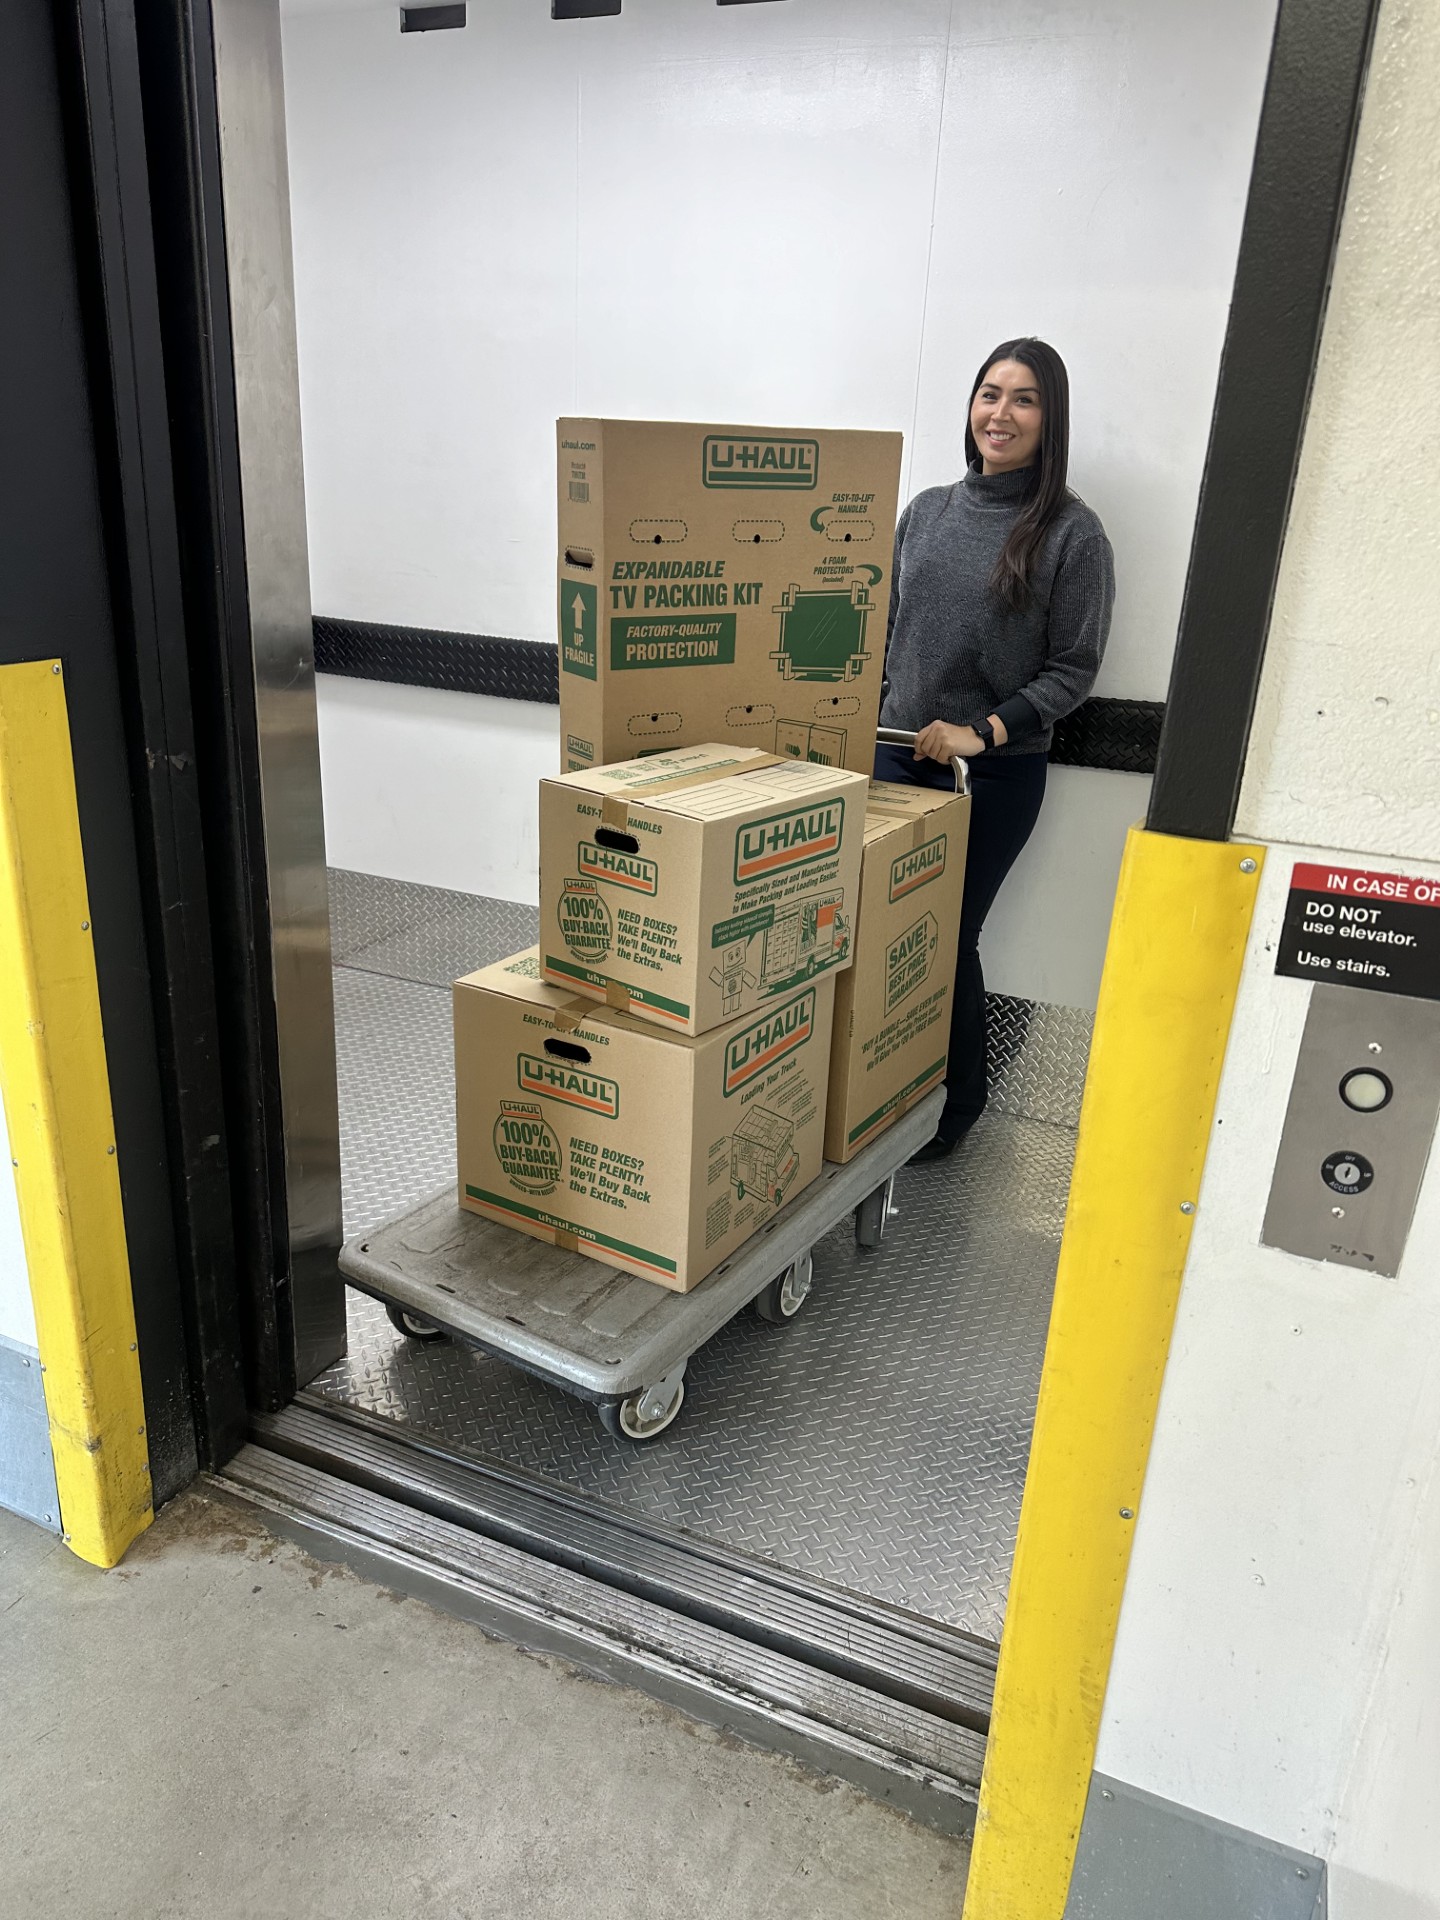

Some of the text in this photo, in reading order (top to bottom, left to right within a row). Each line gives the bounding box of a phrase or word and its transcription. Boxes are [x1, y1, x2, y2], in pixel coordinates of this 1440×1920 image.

[561, 440, 596, 451] uhaul.com
[832, 493, 876, 503] EASY-TO-LIFT
[837, 504, 868, 514] HANDLES
[612, 560, 726, 580] EXPANDABLE
[813, 565, 855, 575] PROTECTORS
[822, 556, 847, 565] 4 FOAM
[610, 582, 763, 609] TV PACKING KIT
[573, 631, 584, 647] UP
[627, 622, 722, 638] FACTORY-QUALITY
[565, 646, 594, 667] FRAGILE
[626, 640, 719, 661] PROTECTION
[627, 817, 663, 835] HANDLES
[734, 858, 839, 902] Specifically Sized and Manufactured
[1326, 874, 1440, 902] IN CASE OF
[740, 898, 757, 912] Make
[758, 890, 783, 905] Packing
[784, 886, 795, 896] and
[796, 877, 818, 892] Loading
[564, 896, 604, 921] 100%
[1306, 902, 1381, 924] DO NOT
[562, 919, 610, 937] BUY-BACK
[618, 909, 678, 936] NEED BOXES?
[1303, 921, 1417, 947] use elevator.
[564, 933, 611, 950] GUARANTEE
[618, 922, 677, 949] TAKE PLENTY!
[889, 921, 928, 970] SAVE!
[617, 934, 683, 965] We'll Buy Back
[617, 947, 631, 960] the
[633, 953, 663, 972] Extras.
[888, 948, 927, 994] BEST PRICE
[1297, 950, 1391, 977] Use stairs.
[573, 1029, 610, 1046] HANDLES
[740, 1081, 765, 1106] Loading
[766, 1070, 780, 1086] Your
[780, 1057, 797, 1076] Truck
[883, 1082, 916, 1113] uhaul.com
[500, 1120, 551, 1148] 100%
[500, 1144, 558, 1166] BUY-BACK
[569, 1137, 645, 1171] NEED BOXES?
[502, 1160, 561, 1182] GUARANTEE
[570, 1151, 645, 1186] TAKE PLENTY!
[569, 1179, 628, 1210] the Extras.
[570, 1165, 652, 1204] We'll Buy Back
[1329, 1181, 1359, 1193] ACCESS
[538, 1213, 597, 1240] uhaul.com
